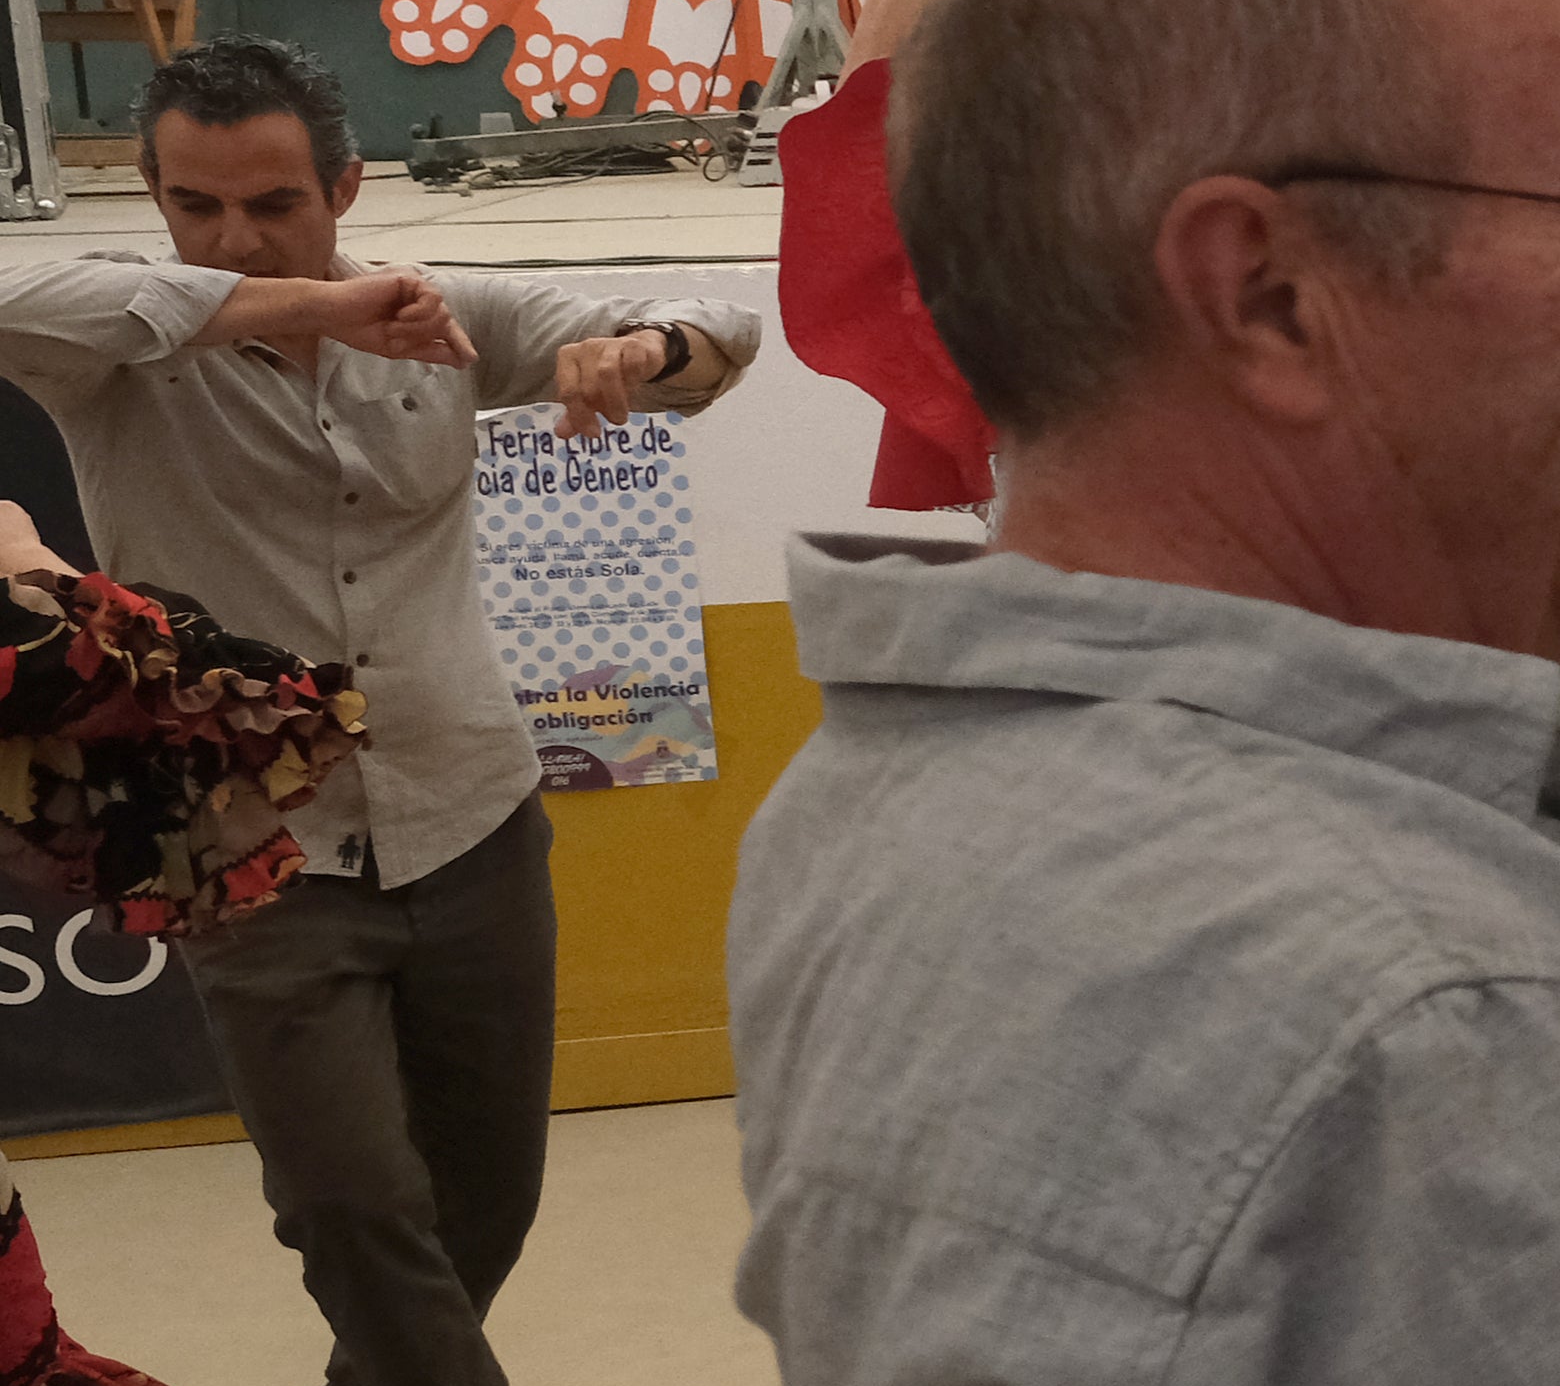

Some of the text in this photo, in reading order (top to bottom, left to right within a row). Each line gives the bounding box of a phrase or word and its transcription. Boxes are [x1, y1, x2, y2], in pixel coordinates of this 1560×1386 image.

[488, 420, 554, 457] Feria
[641, 417, 673, 455] de
[524, 458, 557, 496] de
[566, 455, 658, 492] Género
[515, 567, 541, 581] No
[546, 565, 595, 580] estás
[565, 686, 588, 702] la
[594, 681, 700, 701] Violencia
[533, 708, 653, 730] obligación
